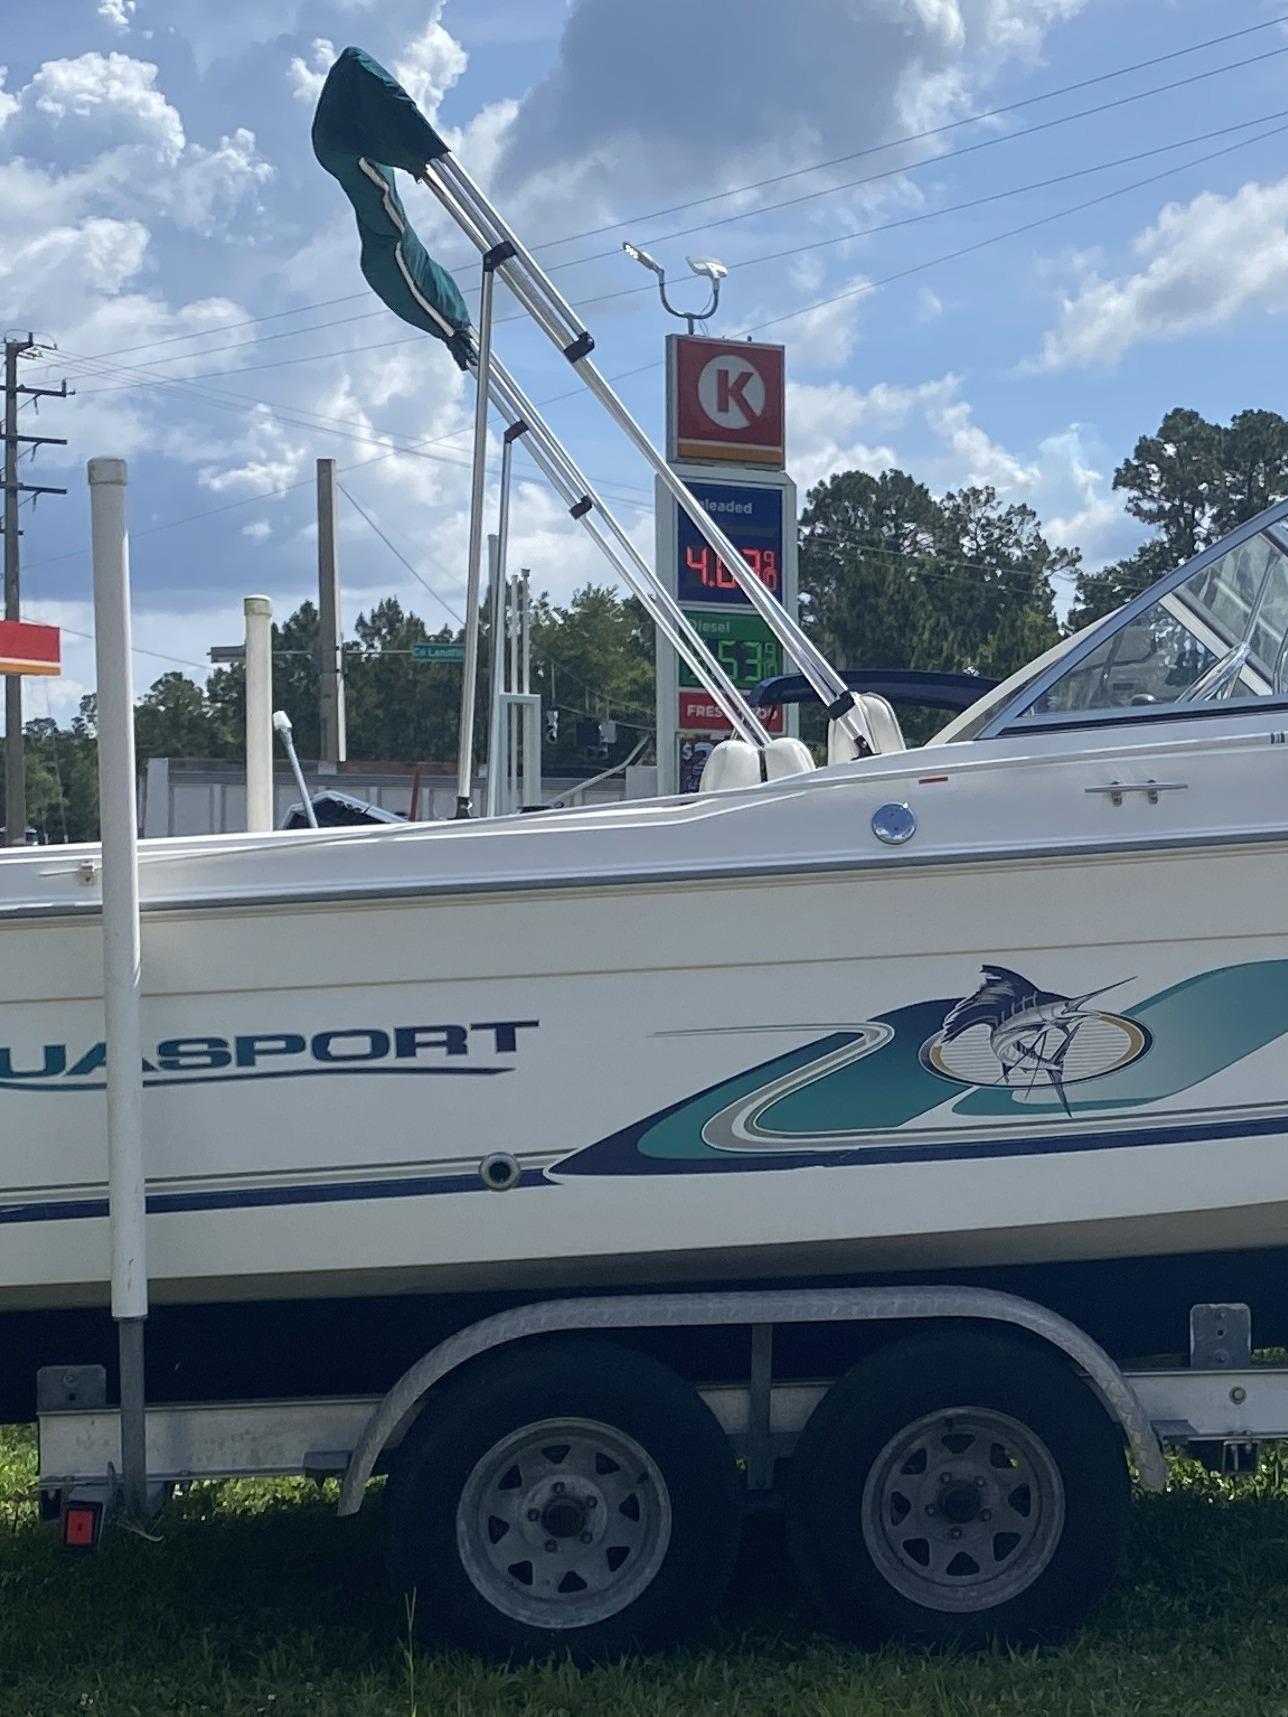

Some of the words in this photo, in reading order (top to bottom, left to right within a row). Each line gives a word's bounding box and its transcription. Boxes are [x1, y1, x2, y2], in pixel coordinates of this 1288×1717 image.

[716, 369, 758, 424] K
[699, 498, 753, 514] leaded
[687, 704, 726, 718] FRES
